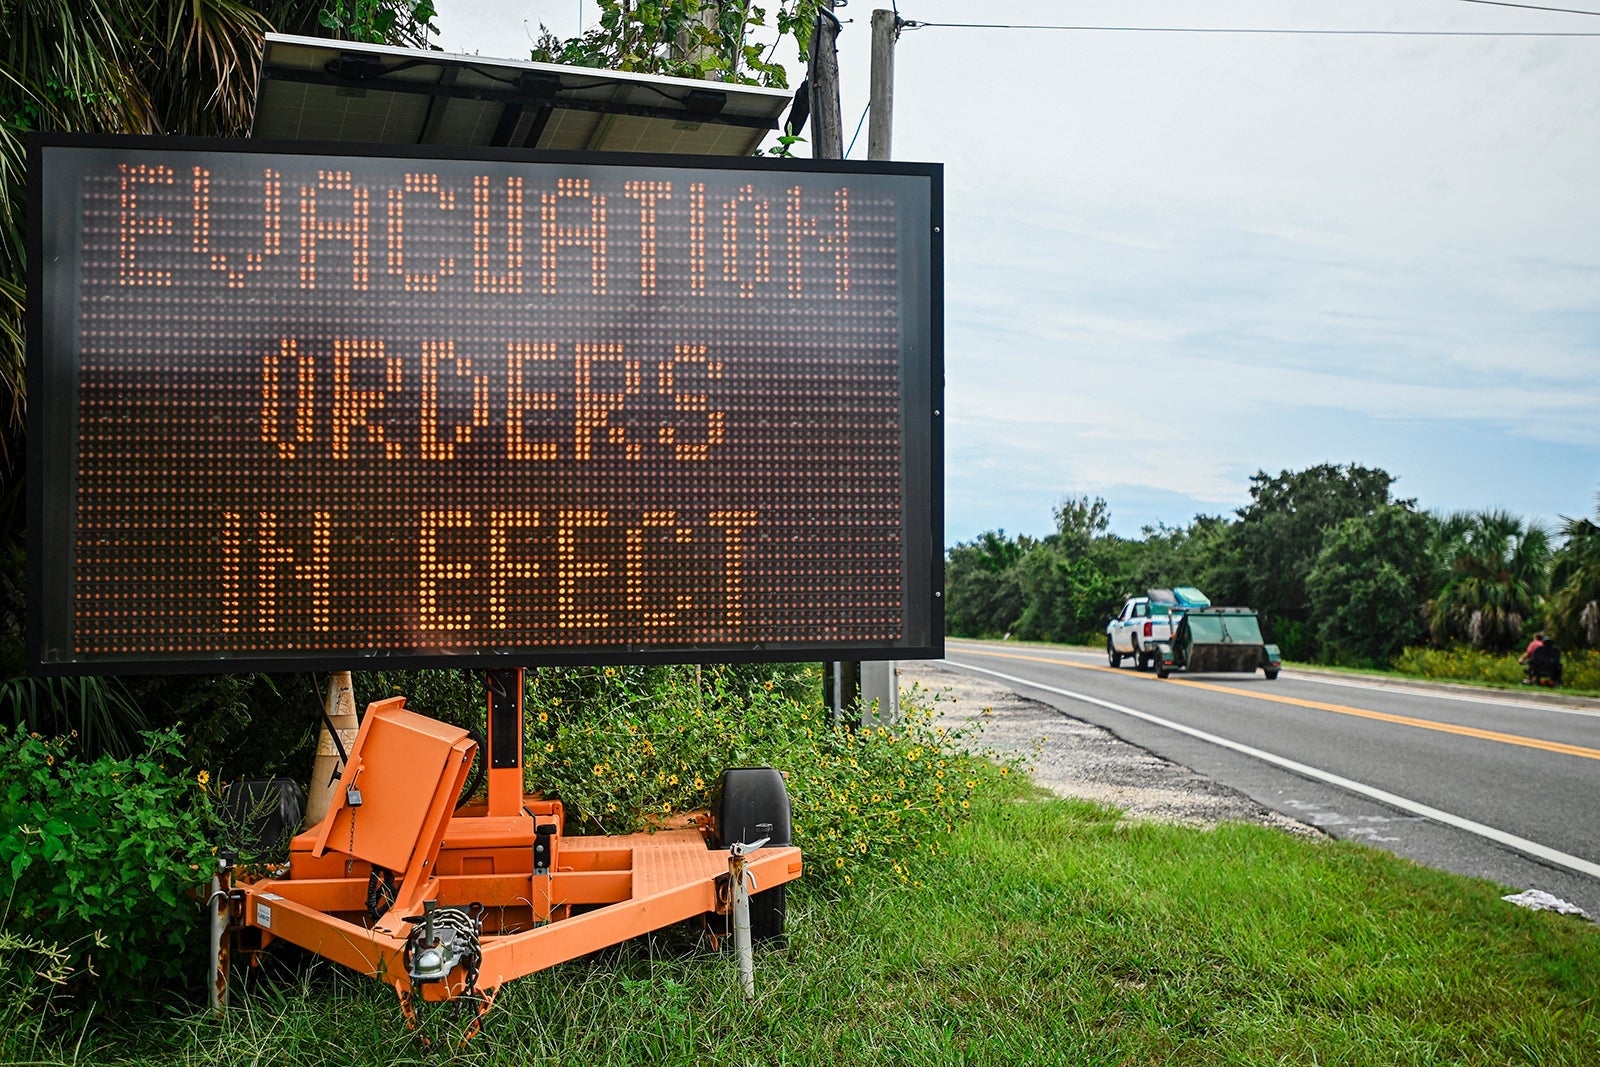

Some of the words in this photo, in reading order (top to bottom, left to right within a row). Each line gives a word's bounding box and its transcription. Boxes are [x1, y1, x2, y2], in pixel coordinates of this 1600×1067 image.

[118, 163, 849, 299] EVACUATION
[261, 338, 724, 461] ORDERS
[221, 511, 331, 633] IN
[419, 510, 757, 631] EFECT
